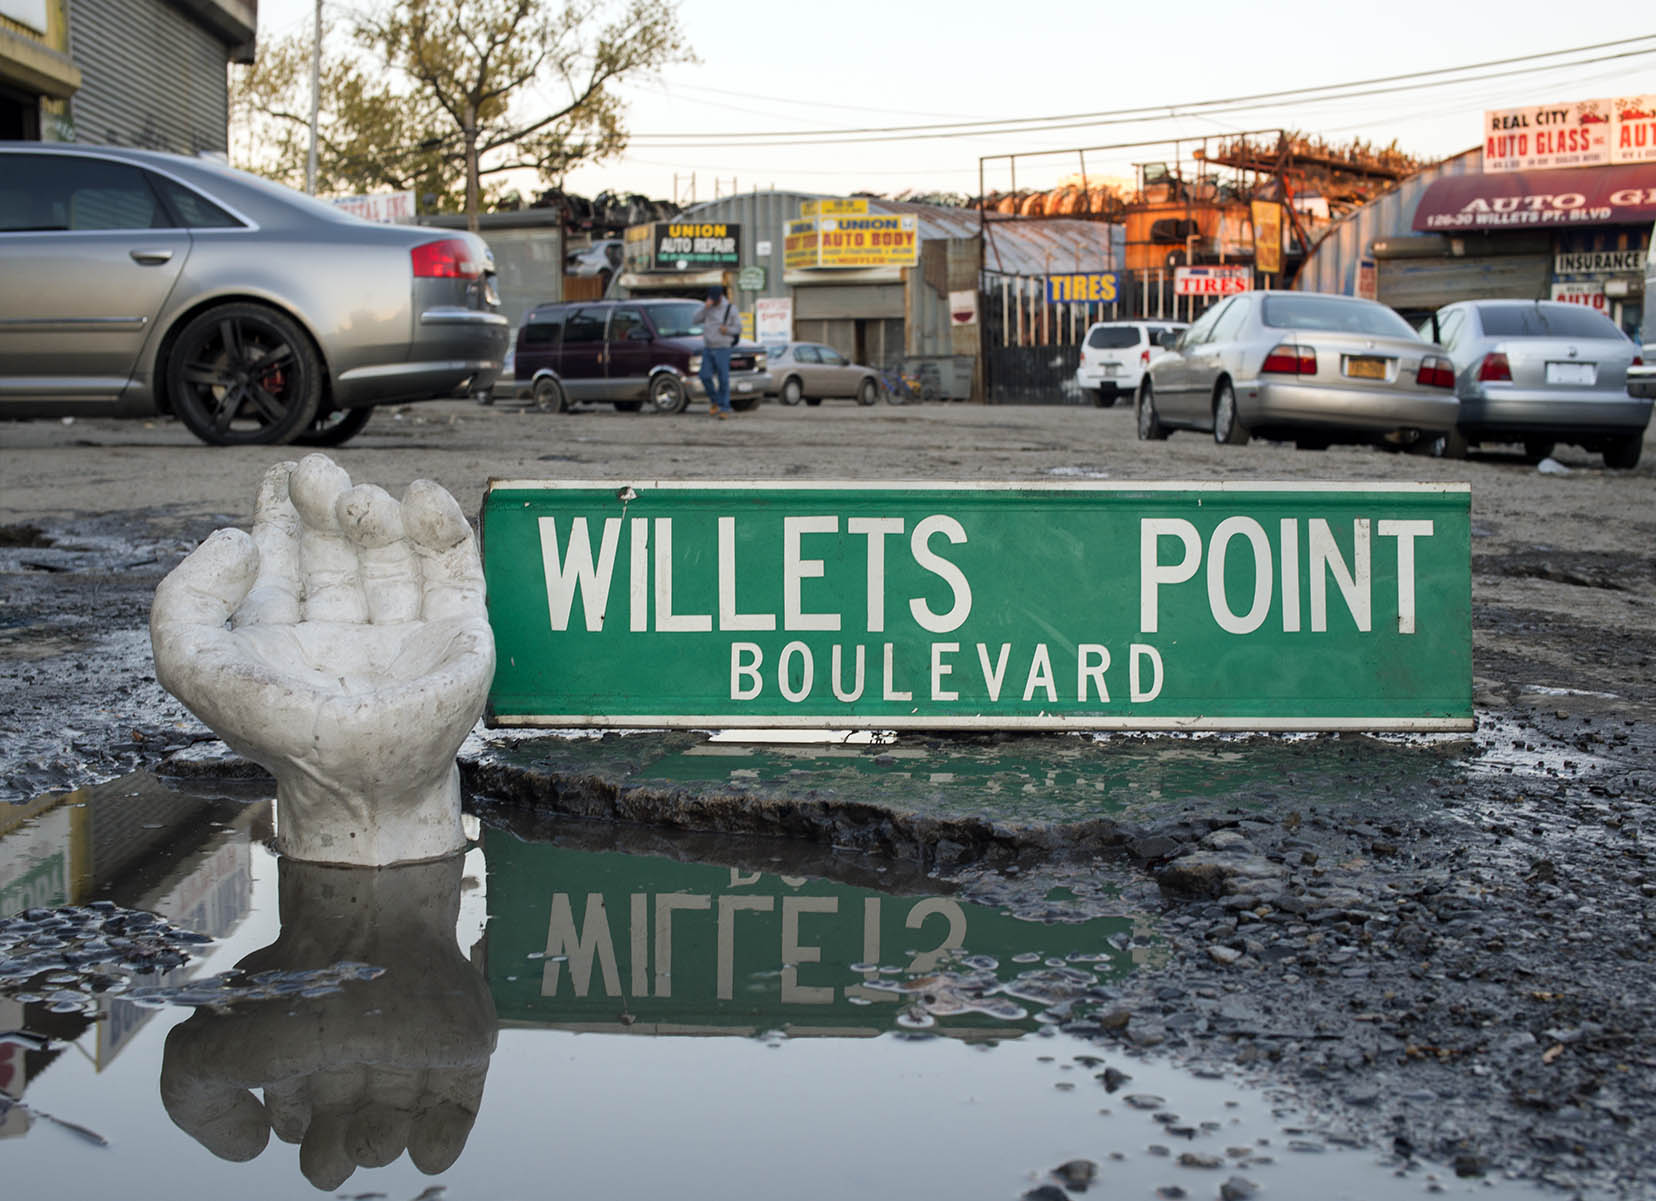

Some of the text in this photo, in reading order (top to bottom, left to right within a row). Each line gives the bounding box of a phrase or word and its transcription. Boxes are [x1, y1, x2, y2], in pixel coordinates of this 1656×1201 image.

[1492, 109, 1569, 131] REAL CITY
[1486, 133, 1529, 159] AUTO
[1536, 127, 1591, 155] GLASS
[1462, 193, 1586, 213] AUTO
[838, 219, 898, 231] UNION
[1475, 210, 1539, 225] WILLETS
[1569, 206, 1612, 221] BLVD
[668, 223, 728, 238] UNION
[822, 232, 866, 247] AUTO
[871, 231, 915, 246] BODY
[659, 238, 692, 253] AUTO
[693, 237, 736, 254] REPAIR
[1559, 252, 1640, 270] INSURANCE
[1049, 274, 1117, 303] TIRES
[1180, 277, 1246, 292] TIRES
[538, 514, 1434, 635] WILLETS POINT
[730, 640, 1164, 703] BOULEVARD
